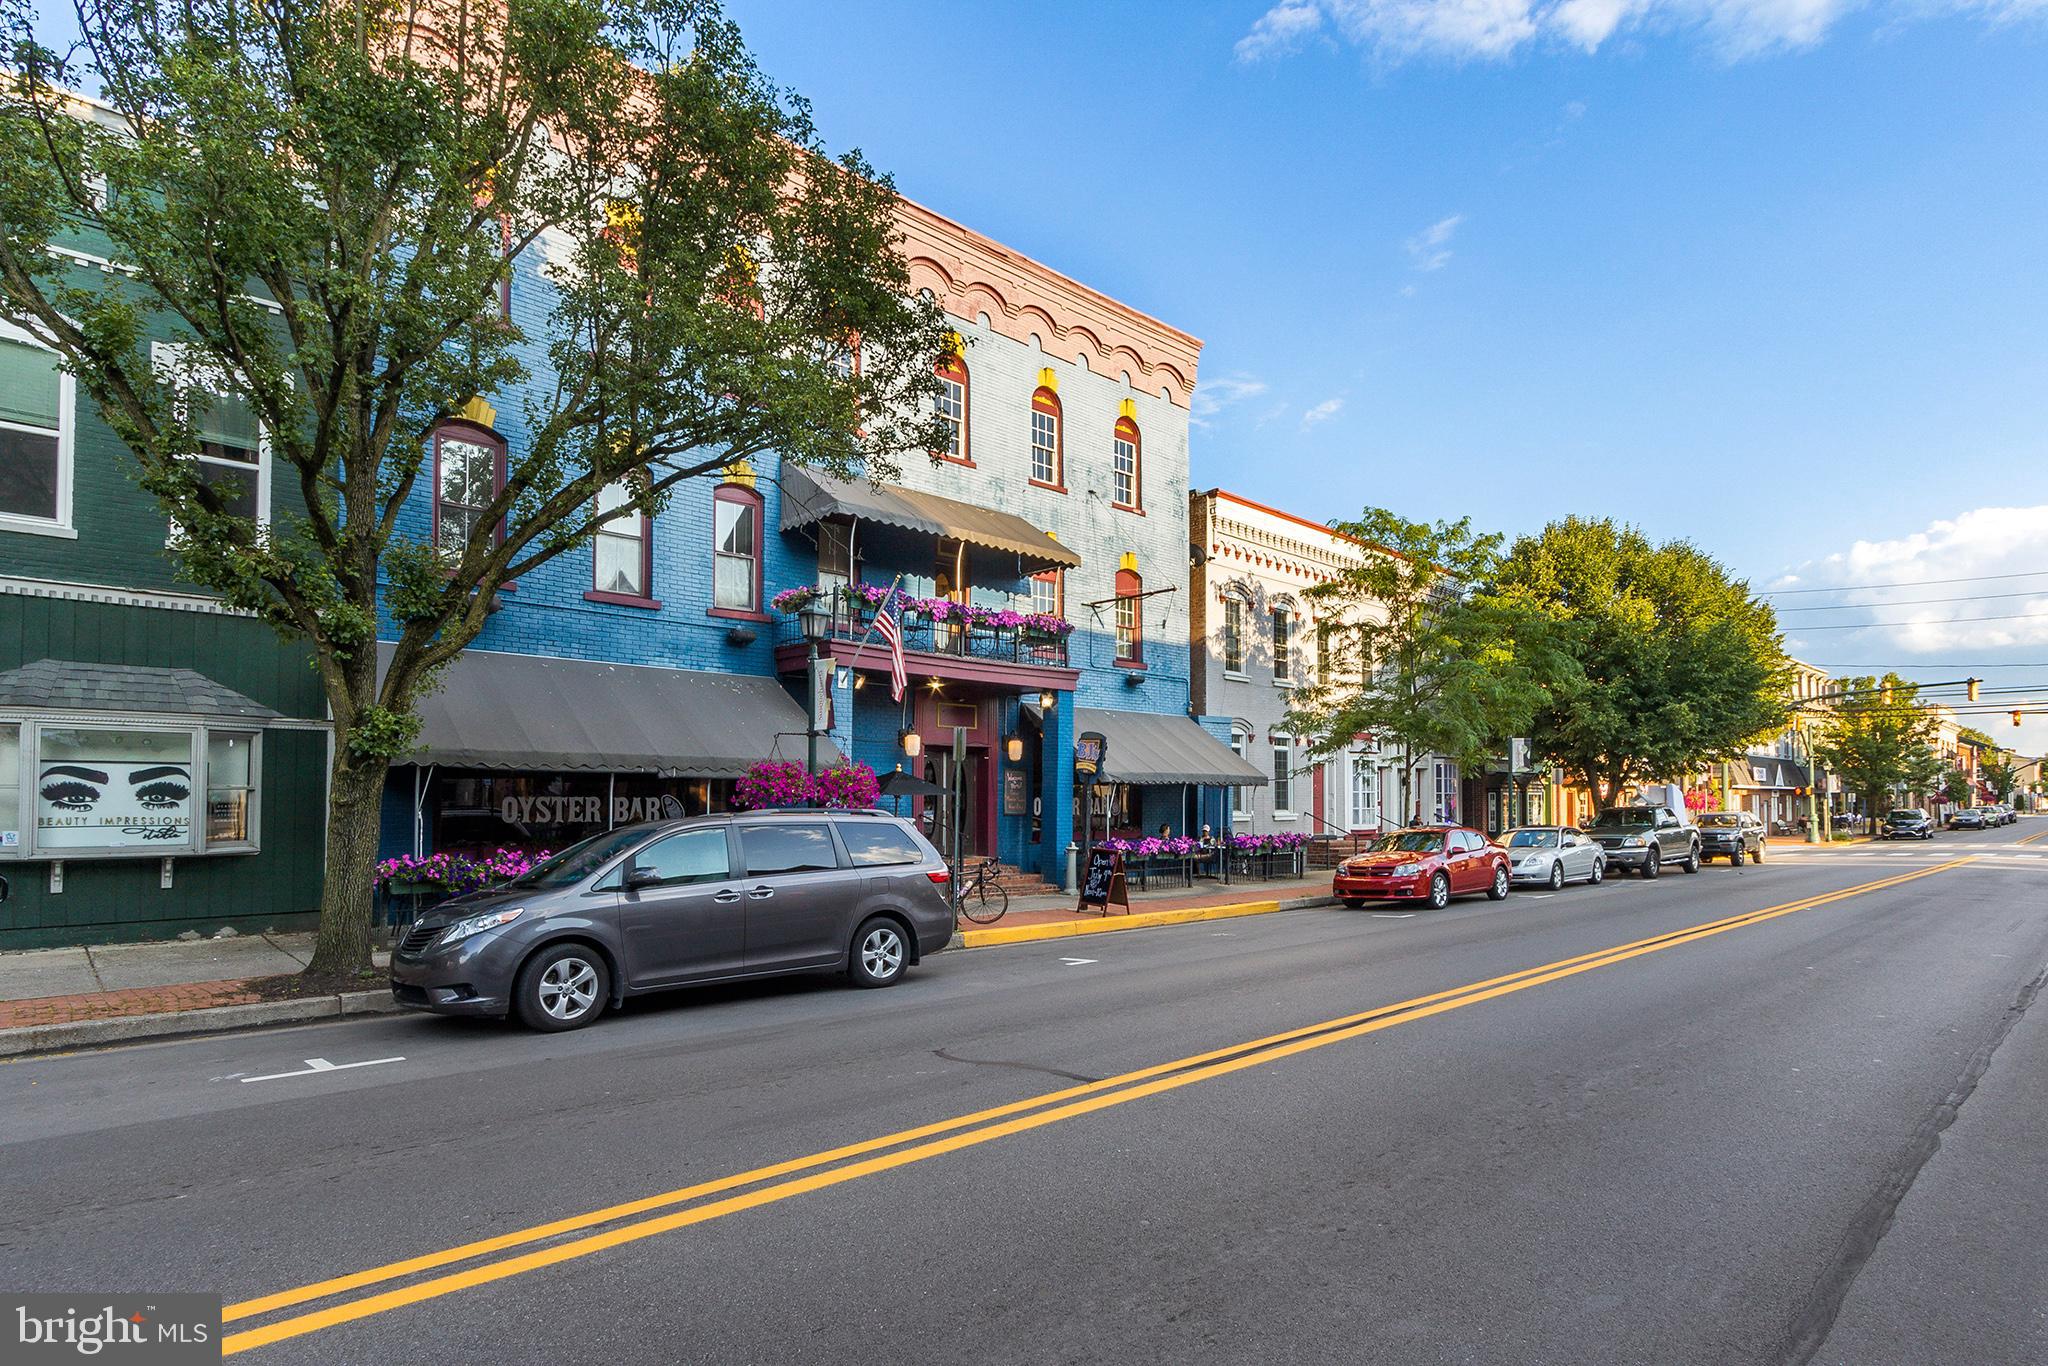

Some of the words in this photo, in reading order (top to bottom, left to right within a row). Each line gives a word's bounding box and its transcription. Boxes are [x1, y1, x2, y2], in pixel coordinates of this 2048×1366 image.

[501, 796, 601, 824] OYSTER
[614, 797, 660, 822] BAR
[38, 817, 88, 826] BEAUTY
[99, 816, 190, 826] IMPRESSIONS
[1093, 854, 1109, 867] Open
[1087, 867, 1102, 884] July
